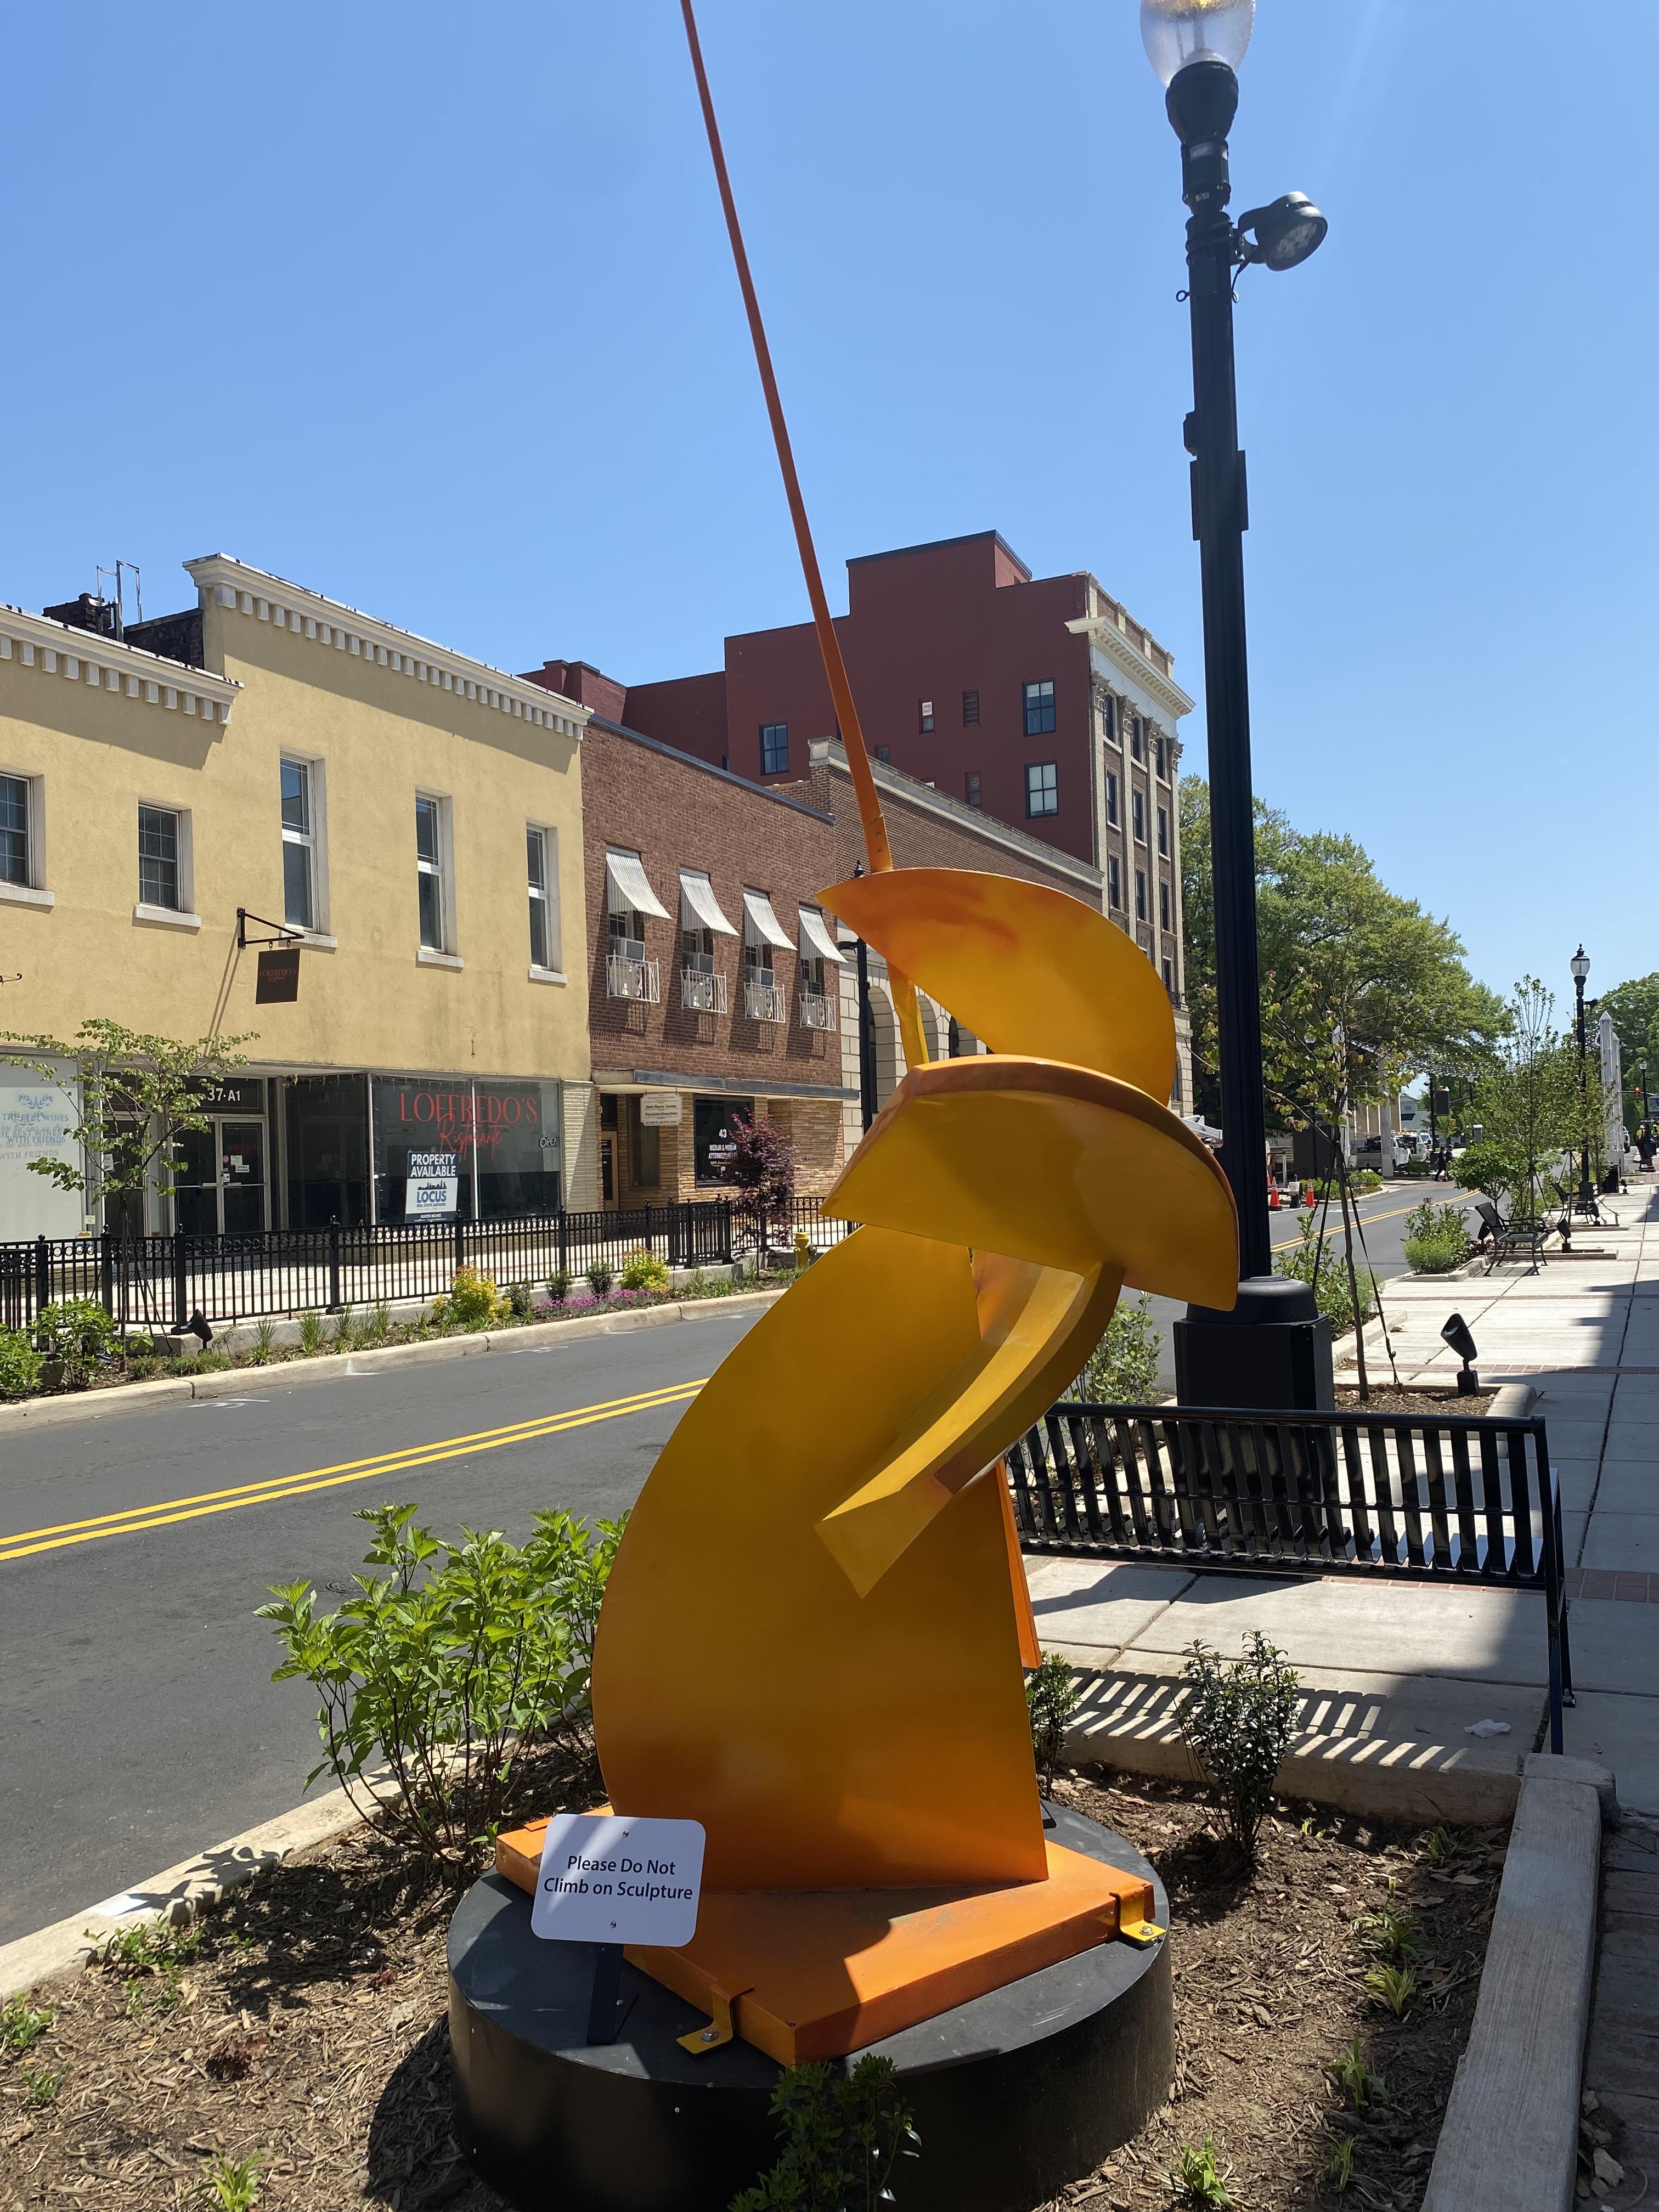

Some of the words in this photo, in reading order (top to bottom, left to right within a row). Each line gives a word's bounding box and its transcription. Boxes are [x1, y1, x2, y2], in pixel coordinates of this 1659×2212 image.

[400, 1093, 538, 1124] LOFFREDO'S
[719, 1128, 727, 1138] 43
[540, 1137, 558, 1148] OPEN
[411, 1154, 456, 1165] PROPERTY
[410, 1166, 456, 1178] AVAILABLE
[417, 1190, 447, 1203] LOCUS
[567, 1855, 617, 1872] Please
[620, 1858, 642, 1873] Do
[647, 1860, 676, 1875] Not
[544, 1877, 589, 1894] Climb
[593, 1883, 612, 1895] on
[617, 1882, 693, 1901] Sculpture
